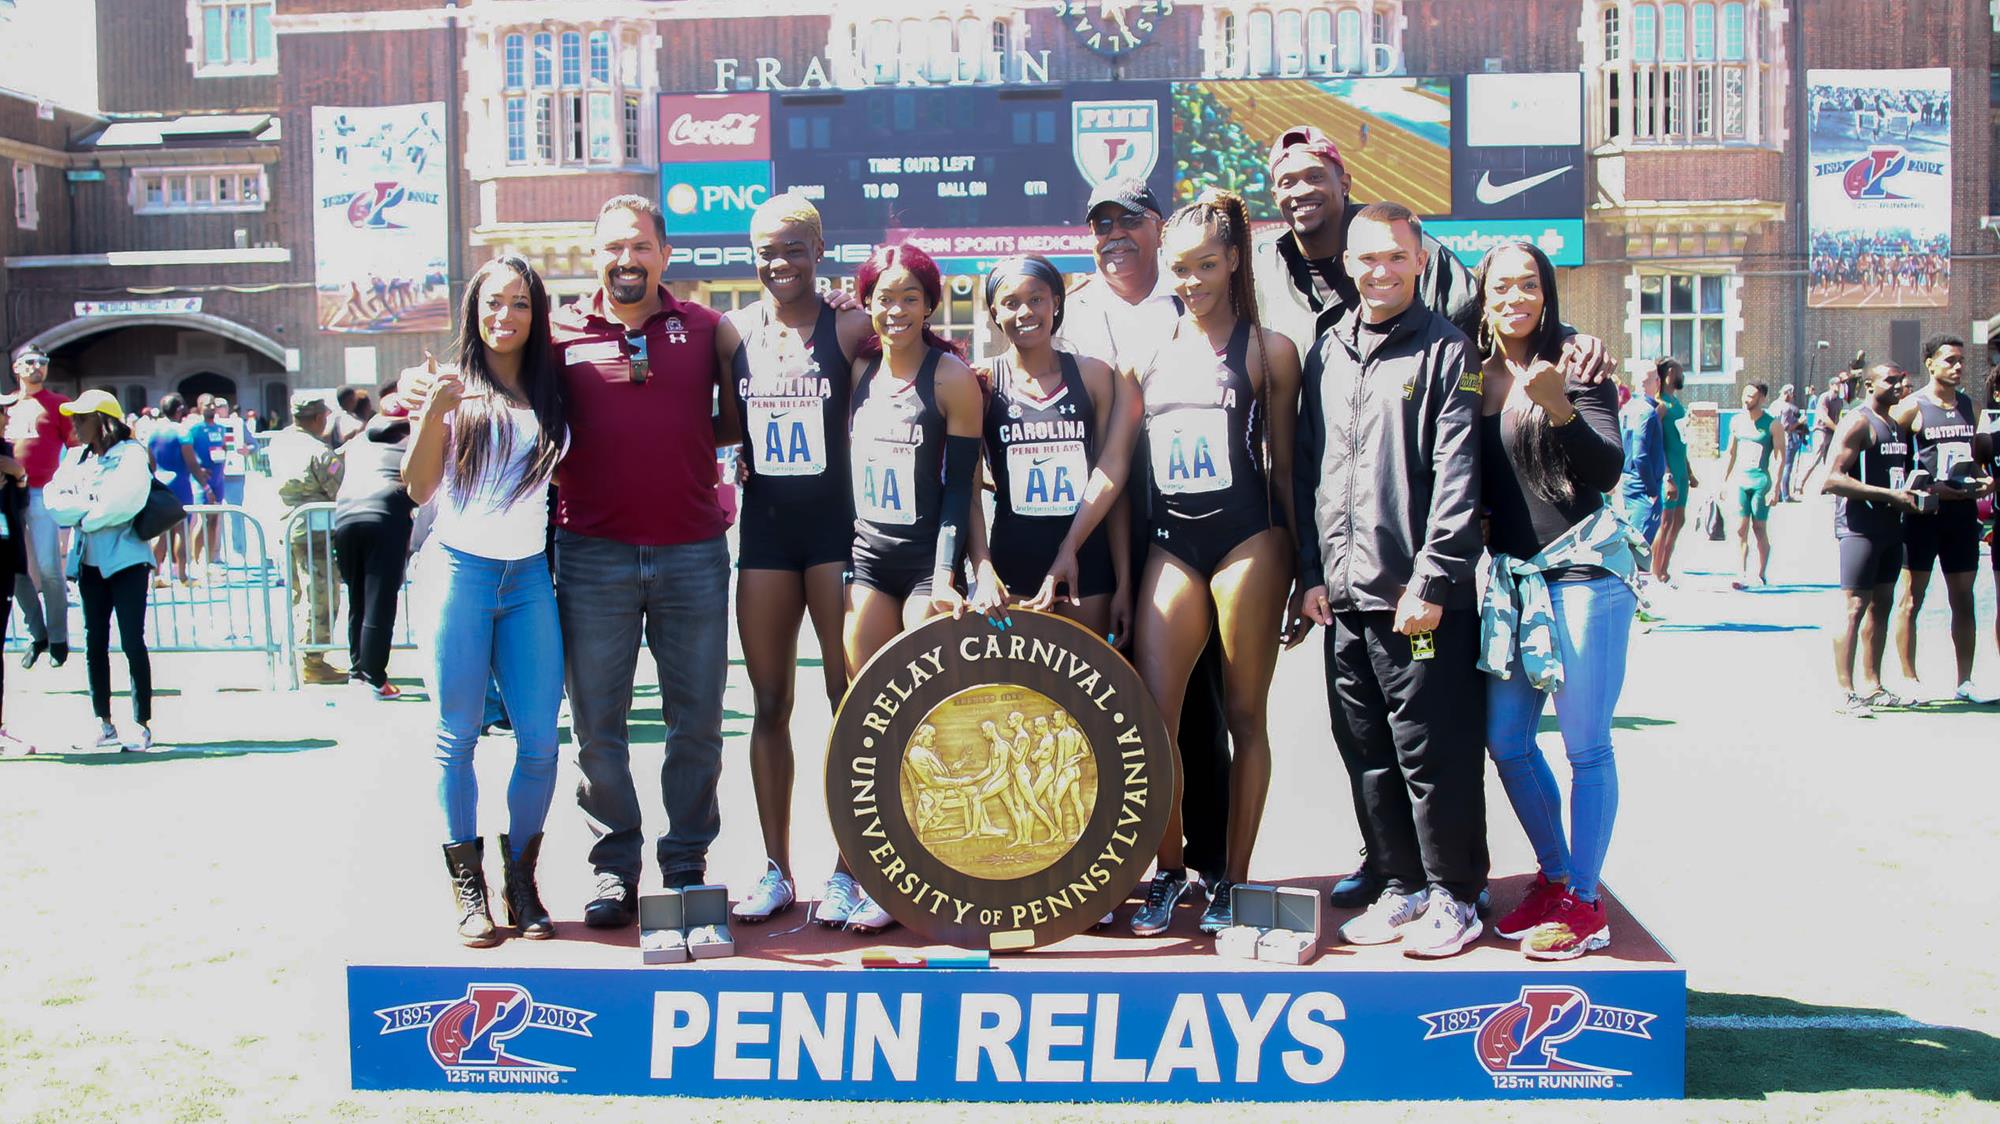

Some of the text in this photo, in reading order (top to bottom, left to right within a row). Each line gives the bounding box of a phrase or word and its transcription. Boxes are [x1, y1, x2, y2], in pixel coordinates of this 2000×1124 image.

[1081, 109, 1149, 129] PENN
[868, 156, 975, 173] TIME OUTS LEFT
[701, 185, 766, 211] PNC
[863, 184, 879, 198] TO
[881, 183, 899, 198] GO
[938, 182, 967, 197] BALL
[969, 181, 987, 196] ON
[1024, 181, 1047, 195] QTR
[668, 244, 873, 267] PORHE
[954, 237, 1015, 252] SPORTS
[739, 377, 832, 400] CAOLINA
[751, 401, 776, 409] PENN
[766, 422, 811, 463] AA
[1000, 421, 1085, 443] CAROLINA
[1012, 446, 1039, 455] PENN
[1169, 436, 1216, 480] AA
[864, 466, 902, 510] AA
[863, 634, 1117, 735] RELAY CARNIVAL
[851, 724, 1149, 928] UNIVERSITY OF PENNSYLVANIA
[394, 1006, 576, 1028] 1895 2019
[1439, 1009, 1635, 1033] 1895 2019
[650, 991, 1346, 1084] PENN RELAYS
[446, 1070, 485, 1083] 125TH
[489, 1070, 559, 1084] RUNNING
[1492, 1076, 1534, 1089] 125TH
[1538, 1076, 1614, 1089] RUNNING
